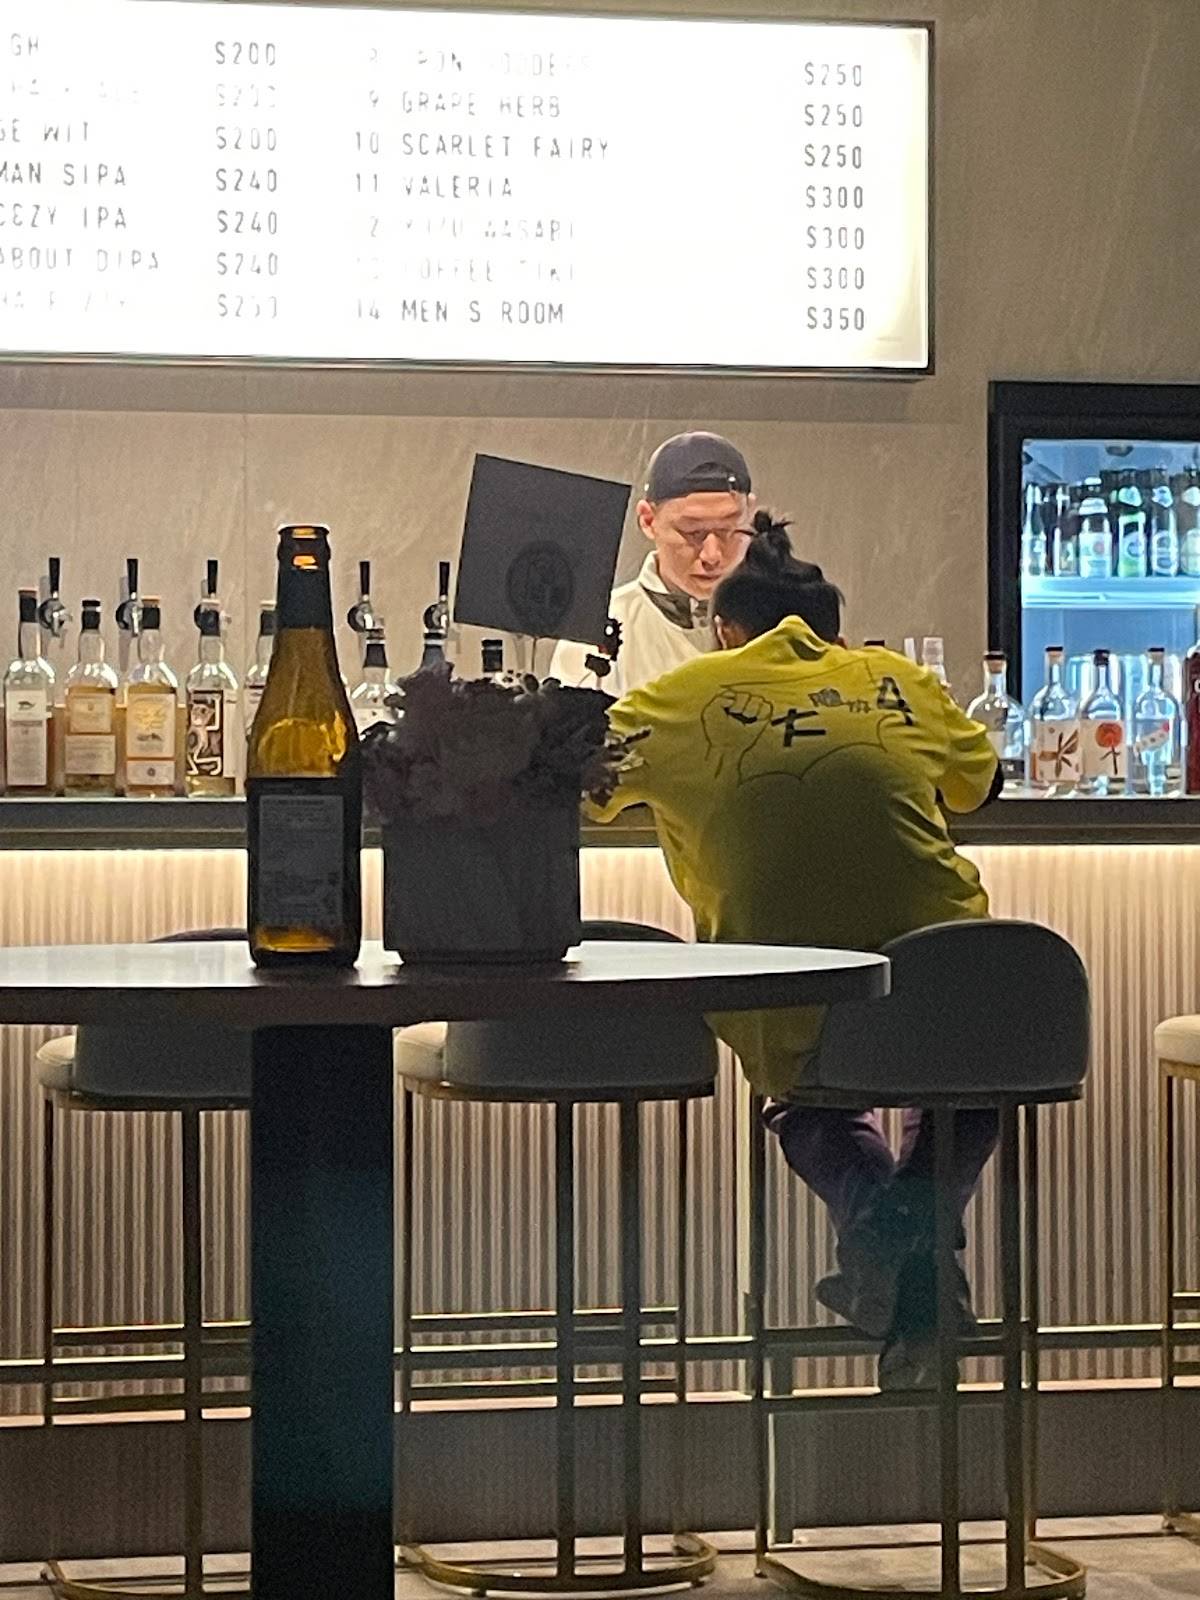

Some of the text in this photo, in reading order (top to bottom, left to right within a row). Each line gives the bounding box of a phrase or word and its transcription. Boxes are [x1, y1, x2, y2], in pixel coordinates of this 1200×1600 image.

[354, 130, 381, 156] 10
[401, 132, 512, 159] SCARLET
[533, 135, 610, 162] FAIRY
[62, 162, 127, 188] SIPA
[355, 171, 379, 194] 11
[404, 174, 514, 200] VALERIA
[82, 205, 128, 231] IPA
[356, 298, 382, 321] 14
[501, 299, 565, 326] ROOM
